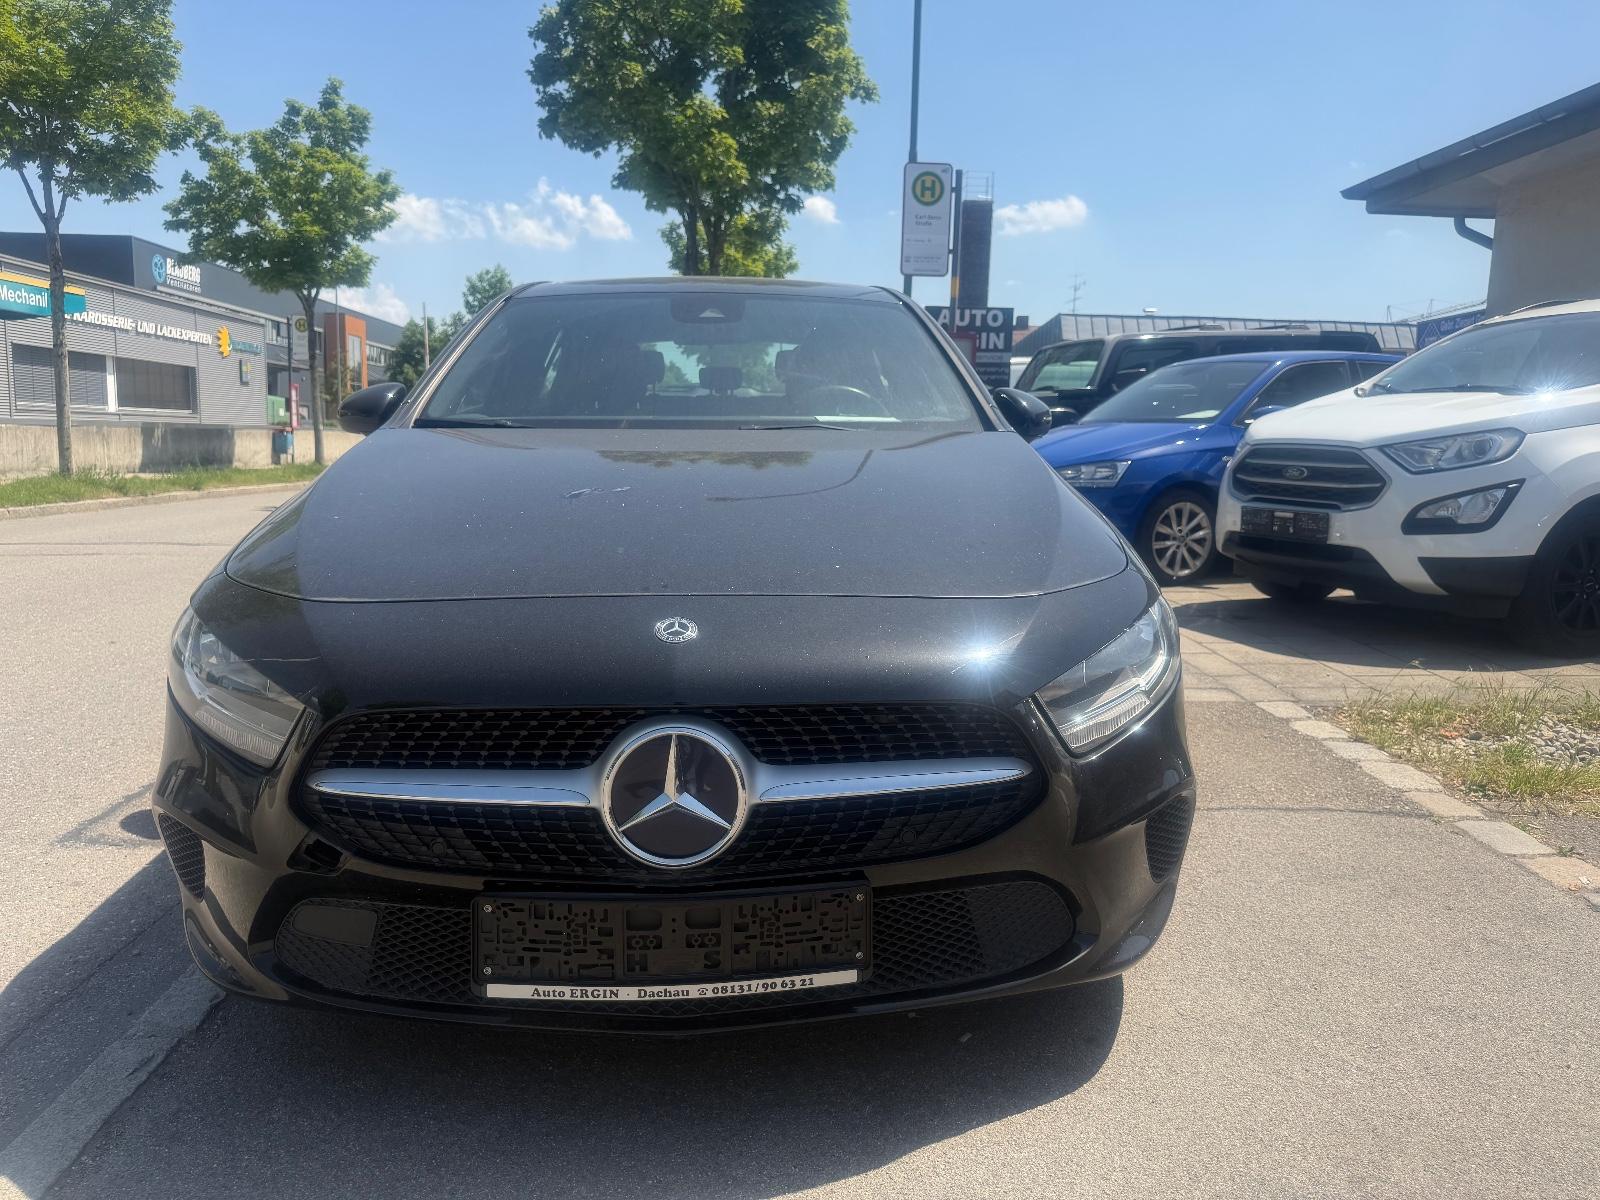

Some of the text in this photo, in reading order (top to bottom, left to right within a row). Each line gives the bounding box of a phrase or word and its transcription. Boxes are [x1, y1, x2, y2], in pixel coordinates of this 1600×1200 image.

[920, 178, 937, 199] H
[166, 257, 201, 283] BLAUBERG
[937, 307, 1005, 328] AUTO
[137, 320, 156, 335] UND
[157, 324, 213, 345] LACKEXPERTEN
[975, 331, 1006, 350] IN
[531, 987, 566, 998] Auto
[569, 988, 620, 999] ERGIN
[637, 987, 690, 999] Dachau
[780, 979, 797, 990] 63
[799, 977, 815, 987] 21
